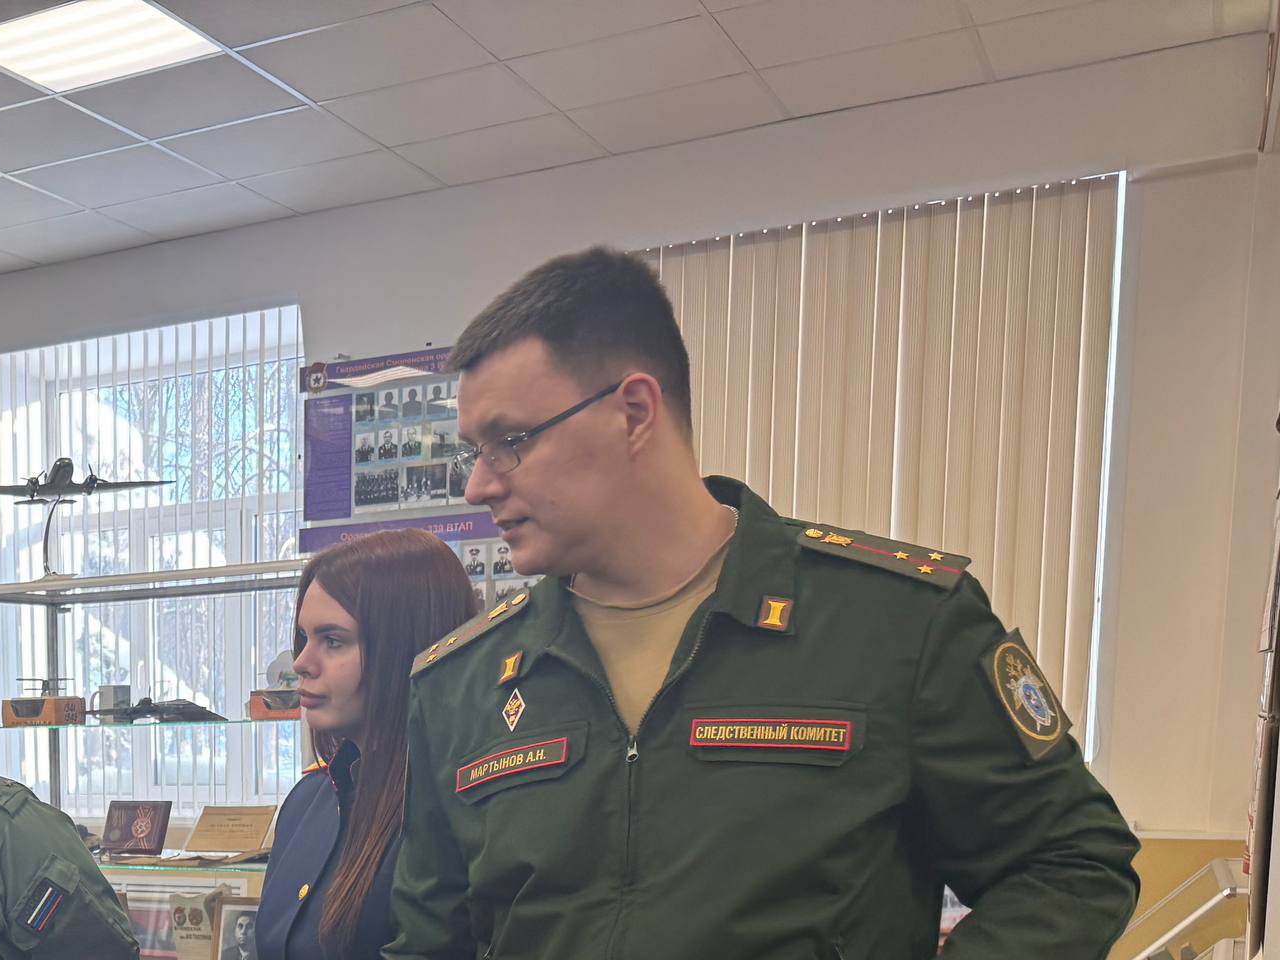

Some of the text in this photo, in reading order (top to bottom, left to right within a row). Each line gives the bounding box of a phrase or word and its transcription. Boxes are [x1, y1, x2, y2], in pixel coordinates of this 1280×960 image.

[446, 521, 473, 533] ВТАП
[695, 723, 846, 743] СЛЕДСТВЕННЫЙ КОМИТЕТ
[470, 749, 547, 782] МАРТЫНОВ А.Н.
